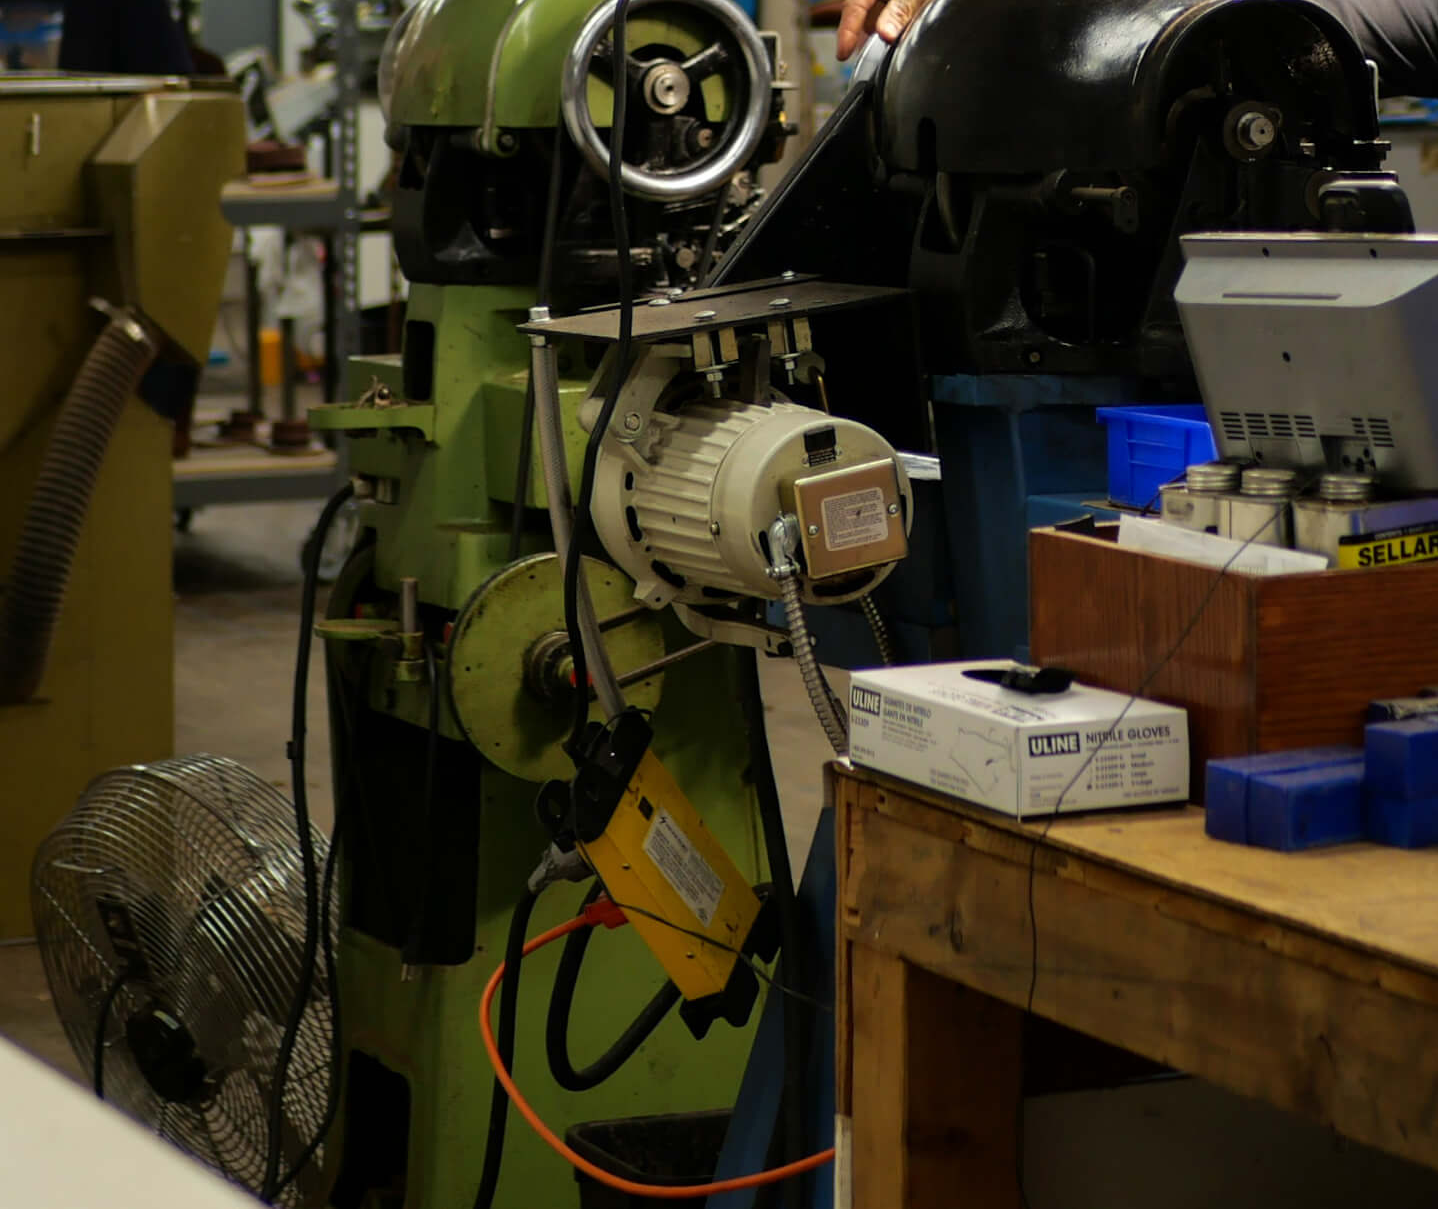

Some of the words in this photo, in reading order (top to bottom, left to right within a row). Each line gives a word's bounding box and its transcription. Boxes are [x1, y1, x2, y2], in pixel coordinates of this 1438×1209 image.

[852, 687, 880, 713] ULINE
[1086, 727, 1124, 744] NITRILE
[1127, 725, 1171, 740] GLOVES
[1031, 735, 1079, 756] ULINE
